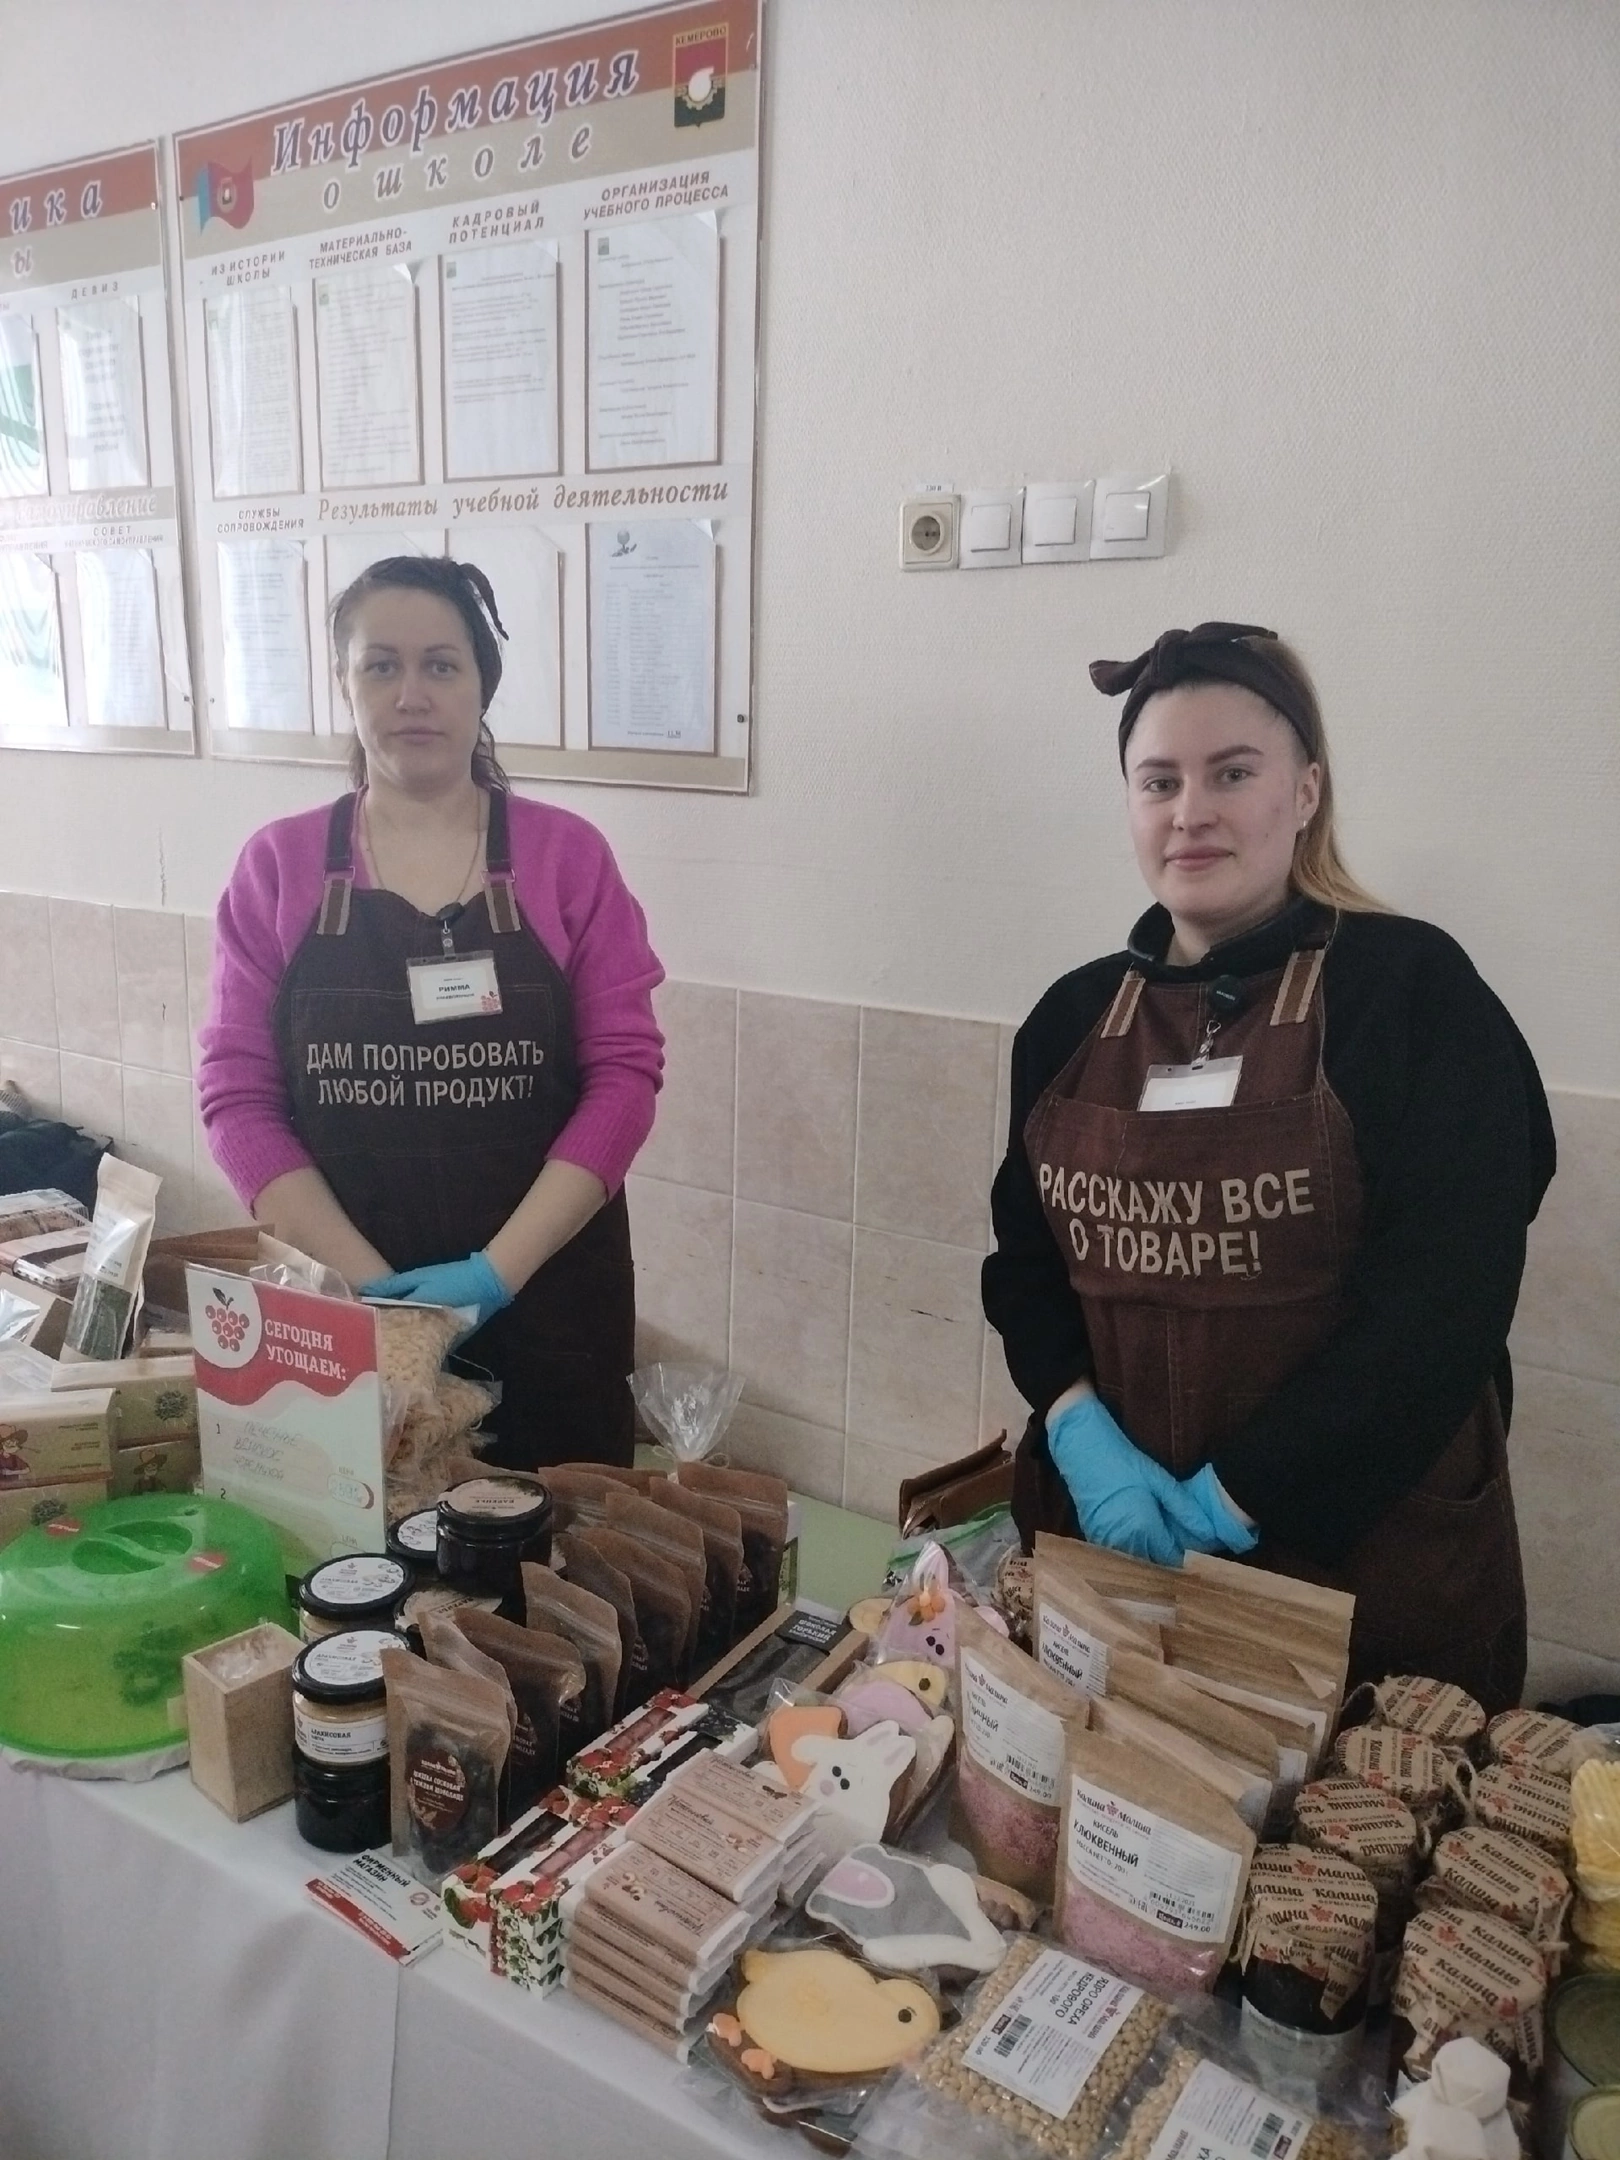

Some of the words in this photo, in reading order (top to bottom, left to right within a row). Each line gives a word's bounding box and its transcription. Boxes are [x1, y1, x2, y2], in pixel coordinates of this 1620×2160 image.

[675, 25, 728, 46] КЕМЕРОВО
[269, 49, 640, 176] Информация
[373, 124, 592, 200] школе
[601, 171, 711, 202] ОРГАНИЗАЦИЯ
[452, 200, 541, 229] КАДРОВЫЙ
[583, 198, 650, 222] УЧЕБНОГО
[654, 185, 729, 210] ПРОЦЕССА
[319, 229, 407, 254] МАТЕРИАЛЬНО-
[448, 216, 545, 245] ПОТЕНЦИАЛ
[211, 264, 227, 277] ИЗ
[229, 250, 287, 273] ИСТОРИИ
[308, 247, 379, 270] ТЕХНИЧЕСКАЯ
[384, 240, 413, 257] БАЗА
[71, 281, 120, 300] ДЕВИЗ
[225, 268, 271, 287] ШКОЛЫ
[238, 508, 282, 520] СЛУЖБЫ
[316, 497, 439, 522] Результаты
[452, 488, 540, 520] учебной
[553, 481, 729, 510] деятельности
[93, 525, 132, 537] СОВЕТ
[217, 519, 305, 534] СОПРОВОЖДЕНИЯ
[438, 984, 471, 993] РИММА
[306, 1042, 353, 1075] ДАМ
[362, 1040, 546, 1072] ПОПРОБОВАТЬ
[318, 1073, 405, 1106] ЛЮБОЙ
[415, 1074, 535, 1109] ПРОДУКТ!
[1038, 1162, 1204, 1226] РАССКАЖУ
[1220, 1167, 1316, 1224] ВСЕ
[1068, 1218, 1090, 1261] О
[1096, 1222, 1263, 1277] ТОВАРЕ!
[264, 1319, 334, 1352] СЕГОДНЯ
[265, 1344, 347, 1382] УГОЩАЕМ:
[216, 1423, 221, 1435] 1
[220, 1488, 227, 1500] 2
[1076, 1789, 1106, 1812] Калина
[1118, 1811, 1152, 1835] Малина
[1328, 1799, 1385, 1811] Малина
[1092, 1820, 1119, 1838] КИСЕЛЬ
[1346, 1819, 1404, 1832] Калина
[1073, 1818, 1139, 1868] КЛЮКВЕННЫЙ
[352, 1859, 388, 1883] МАГАЗИН
[361, 1854, 411, 1888] ФИРМЕННЫЙ
[1250, 1862, 1294, 1874] алина
[1480, 1843, 1537, 1880] Калина
[1313, 1887, 1378, 1905] Калина
[1471, 1924, 1536, 1967] Калина
[1455, 1942, 1521, 1986] Малина
[1055, 1972, 1095, 2018] КЕДРОВОГО
[1088, 1976, 1110, 1999] ЯДРО
[1435, 1958, 1499, 2007] Калина
[1067, 1997, 1093, 2026] ОРЕХА
